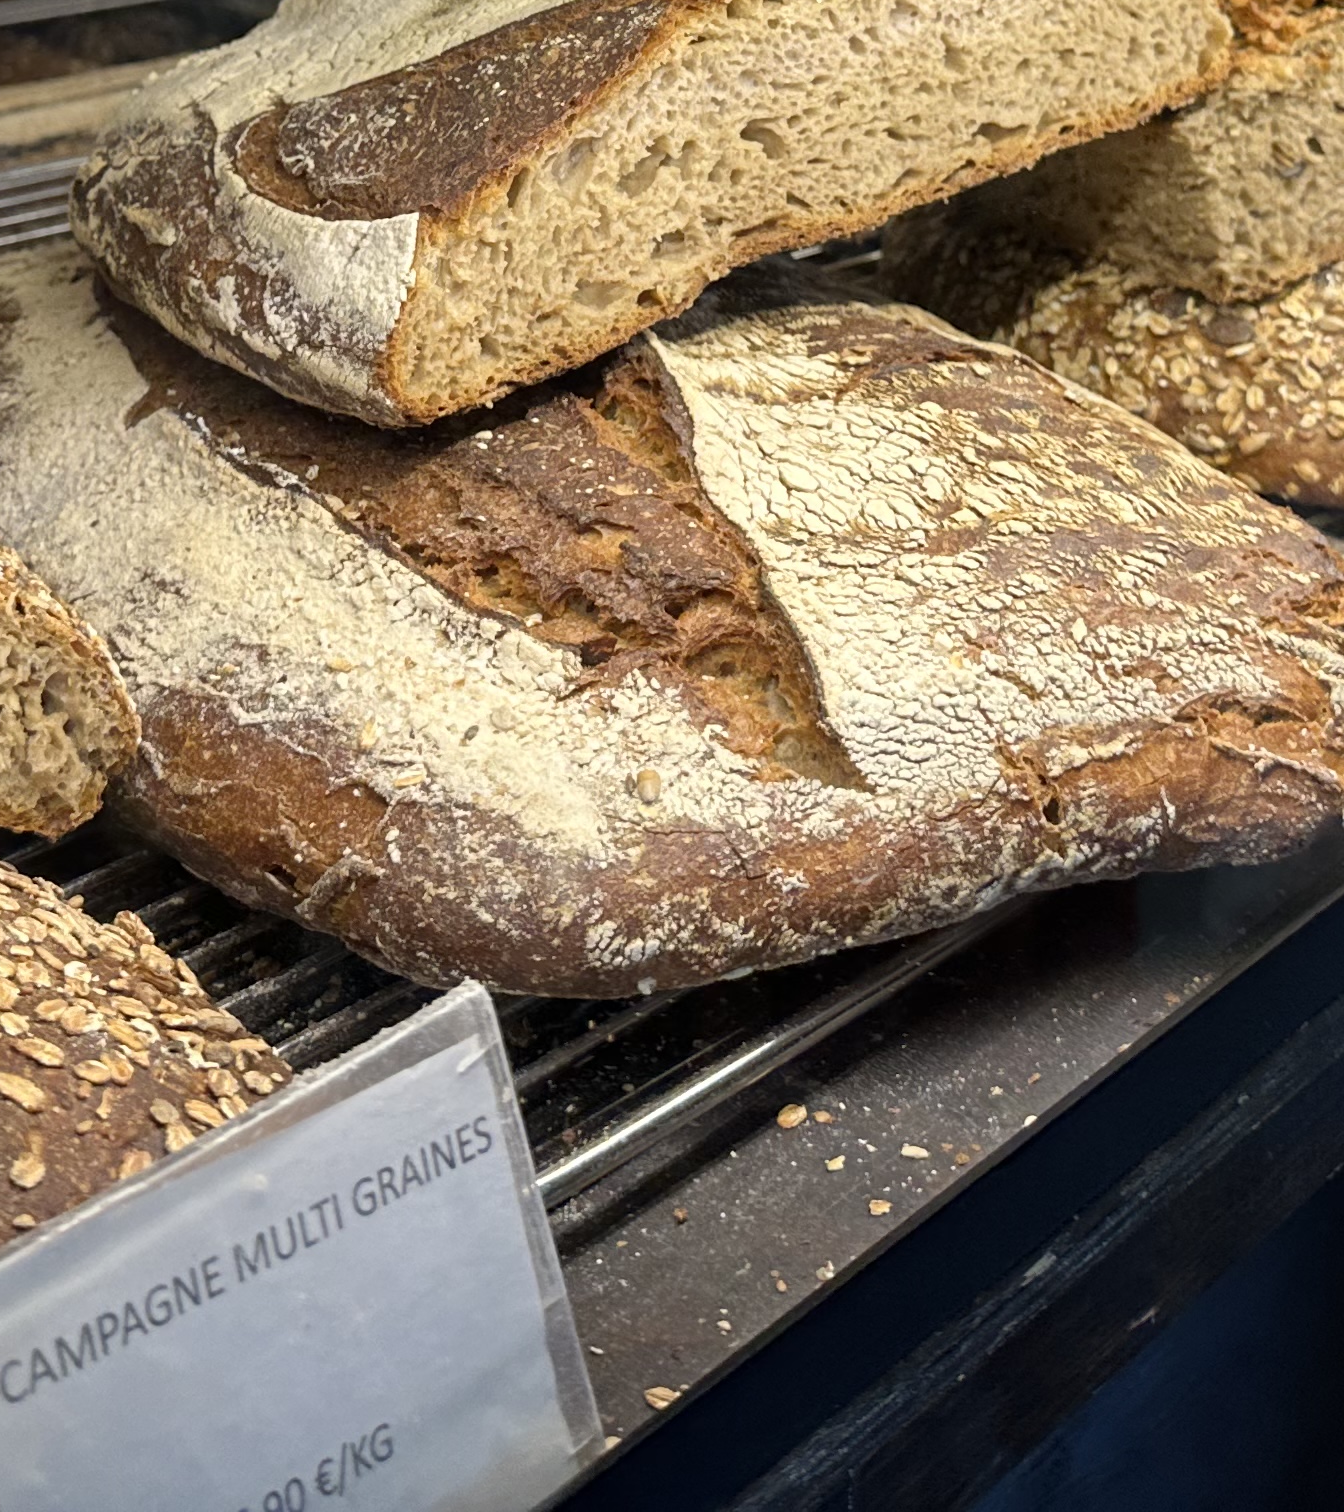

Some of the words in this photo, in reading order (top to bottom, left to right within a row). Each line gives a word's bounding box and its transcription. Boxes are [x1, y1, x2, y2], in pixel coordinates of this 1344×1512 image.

[231, 1192, 346, 1285] MULTI
[351, 1115, 495, 1219] GRAINES
[314, 1422, 395, 1497] €/KG
